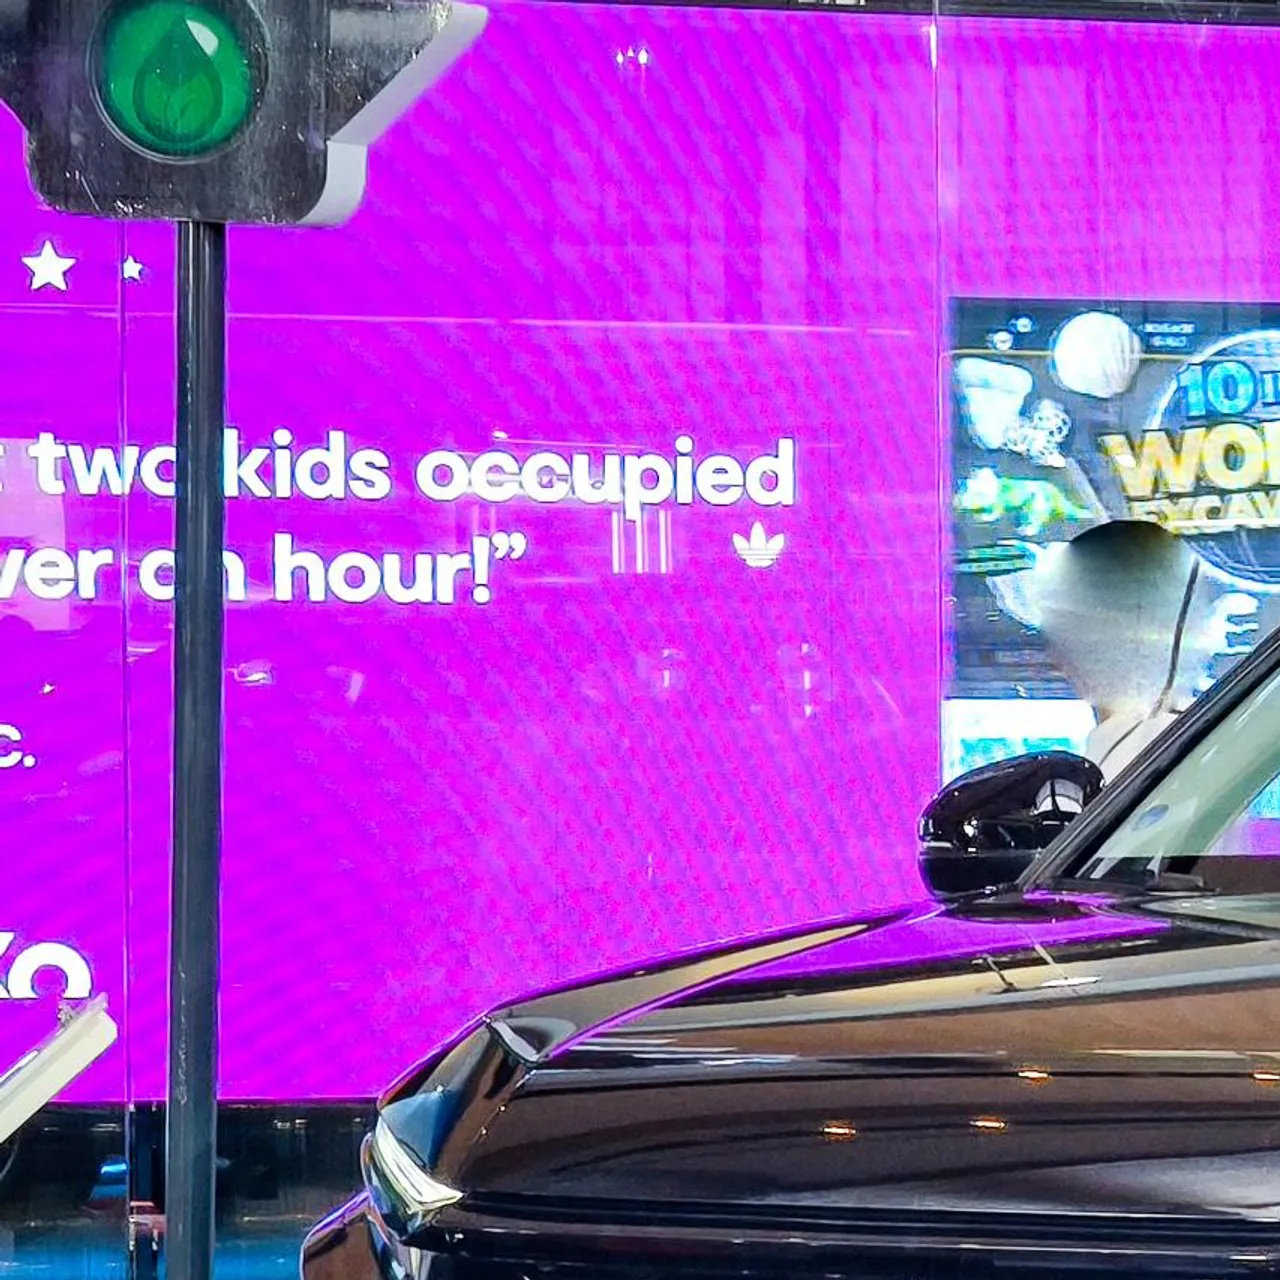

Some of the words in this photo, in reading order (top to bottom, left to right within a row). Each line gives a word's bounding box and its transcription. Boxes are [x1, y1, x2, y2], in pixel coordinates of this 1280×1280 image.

[1175, 360, 1257, 417] 10
[223, 427, 392, 501] kids
[414, 434, 796, 524] occupied
